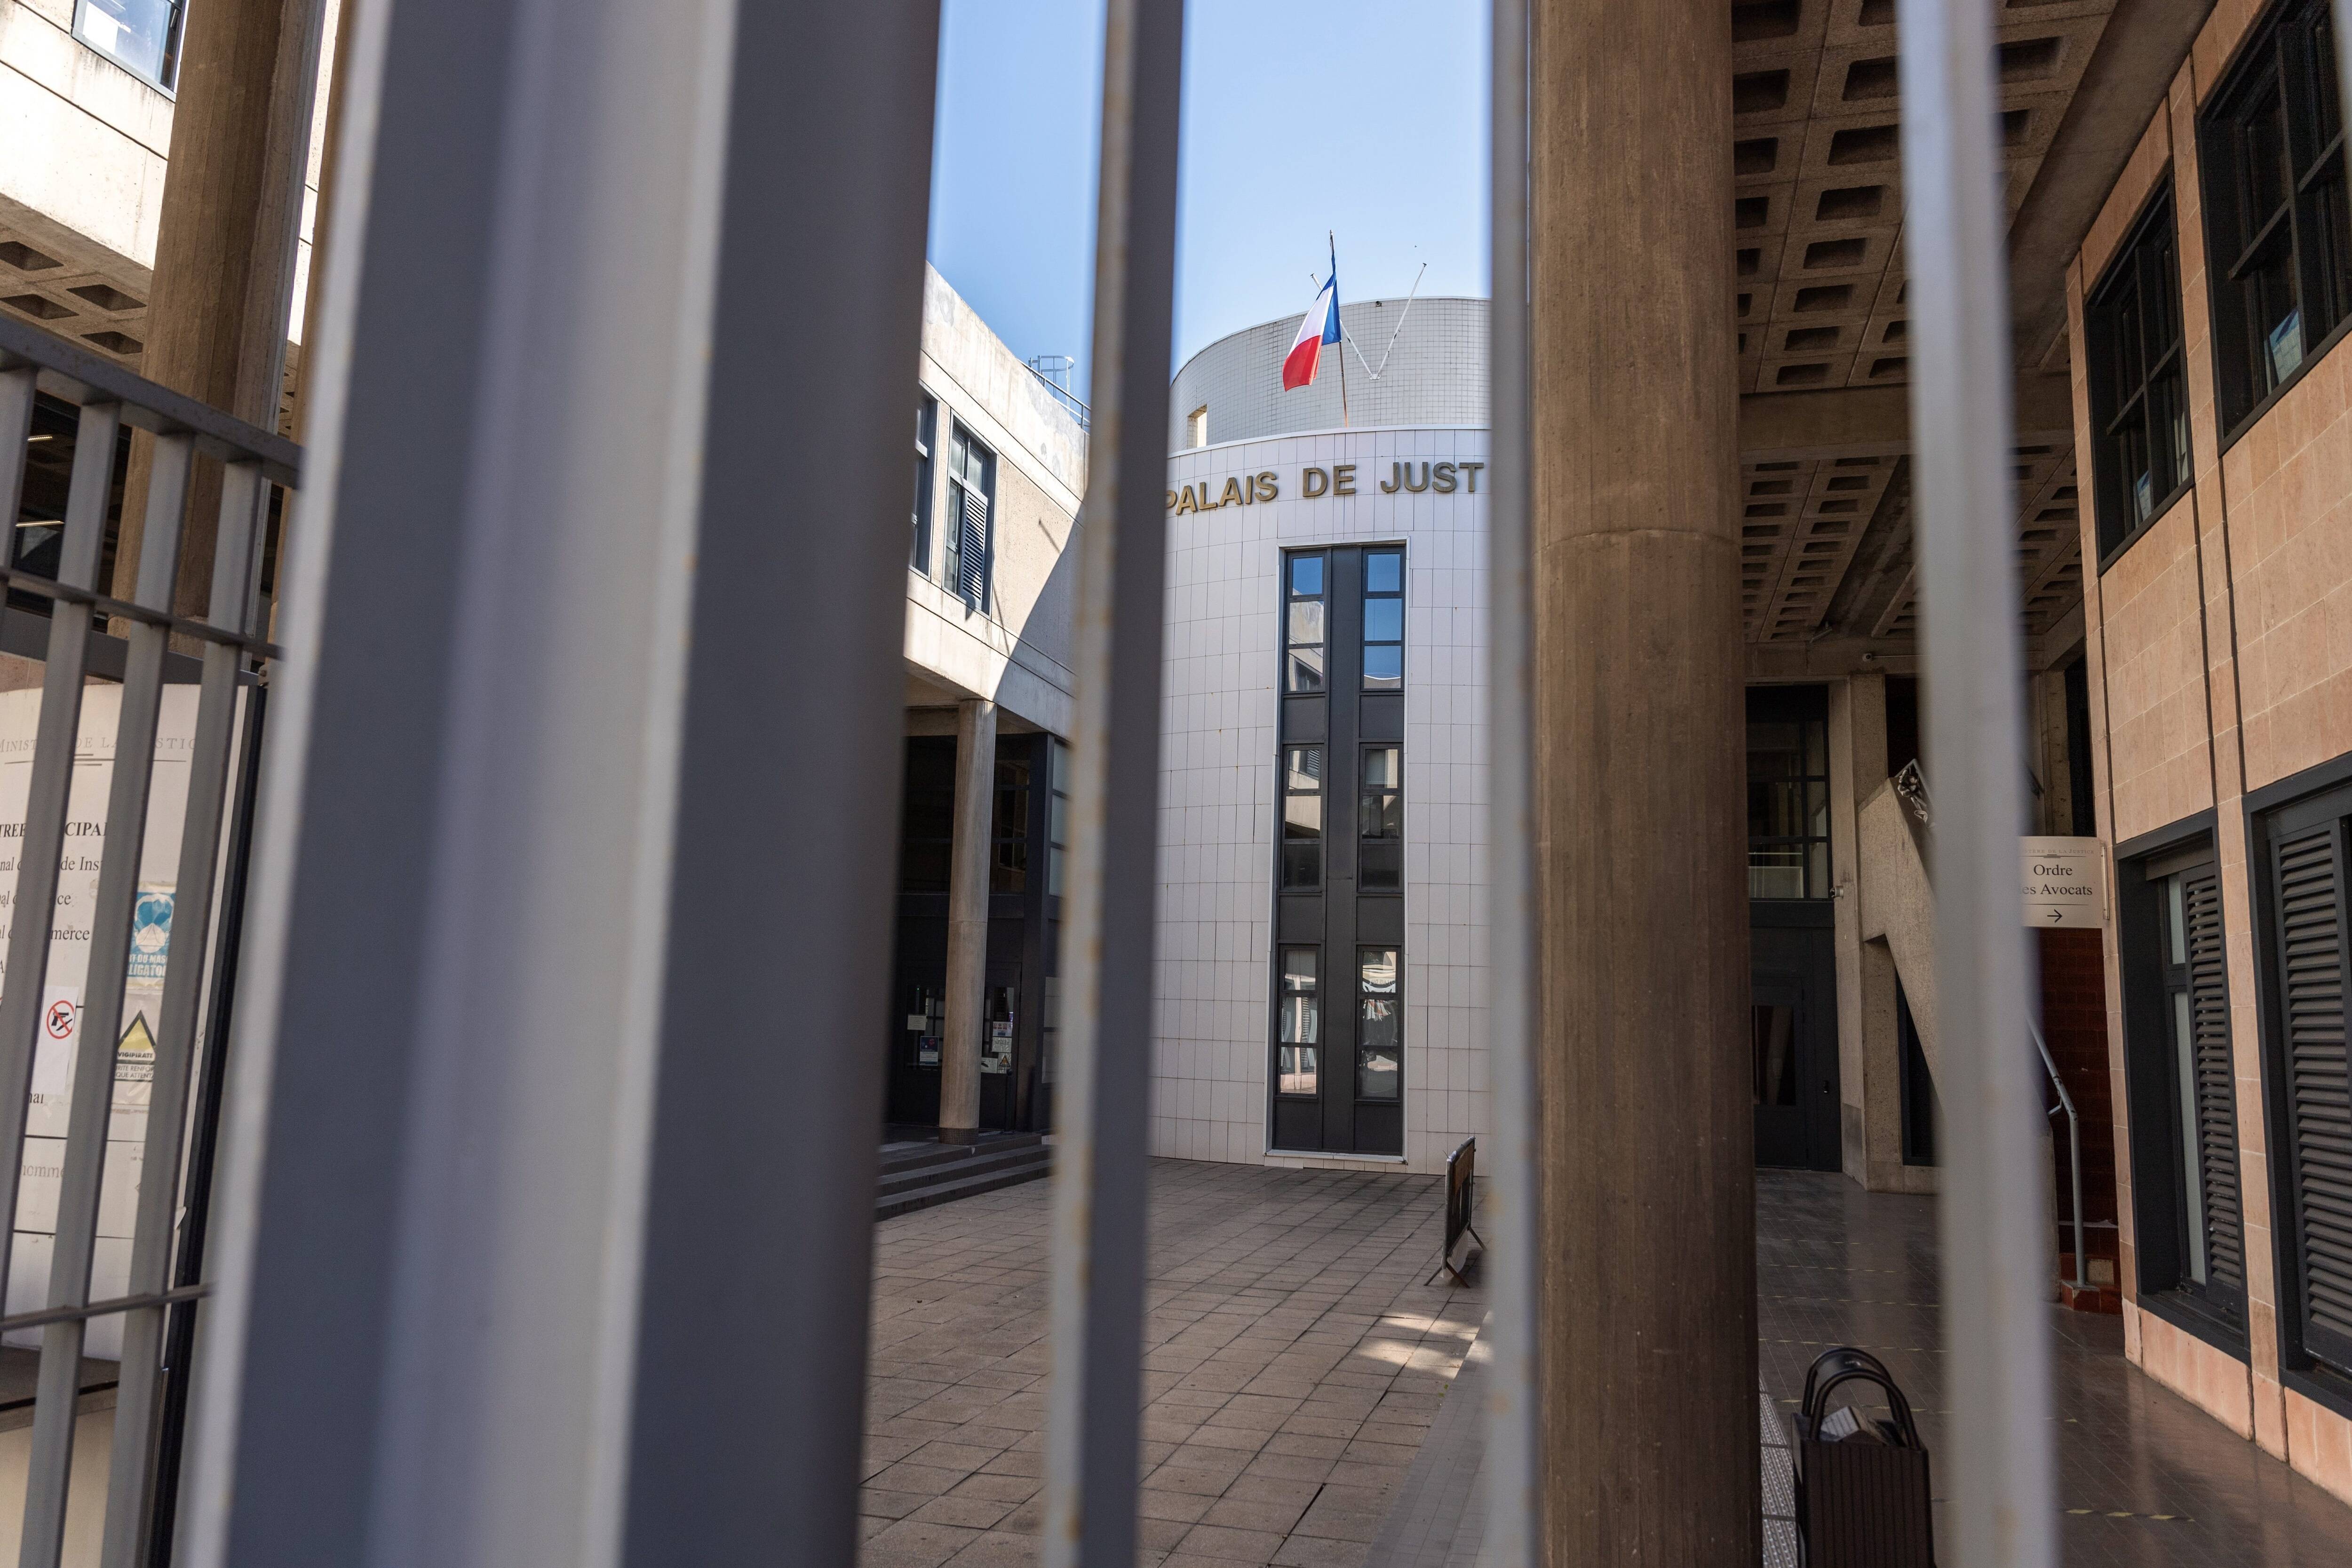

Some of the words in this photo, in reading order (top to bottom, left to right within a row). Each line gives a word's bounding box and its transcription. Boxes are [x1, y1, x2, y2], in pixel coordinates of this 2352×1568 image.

[1303, 465, 1356, 497] DE
[2034, 864, 2073, 876] Ordre
[2041, 884, 2092, 895] Avocats
